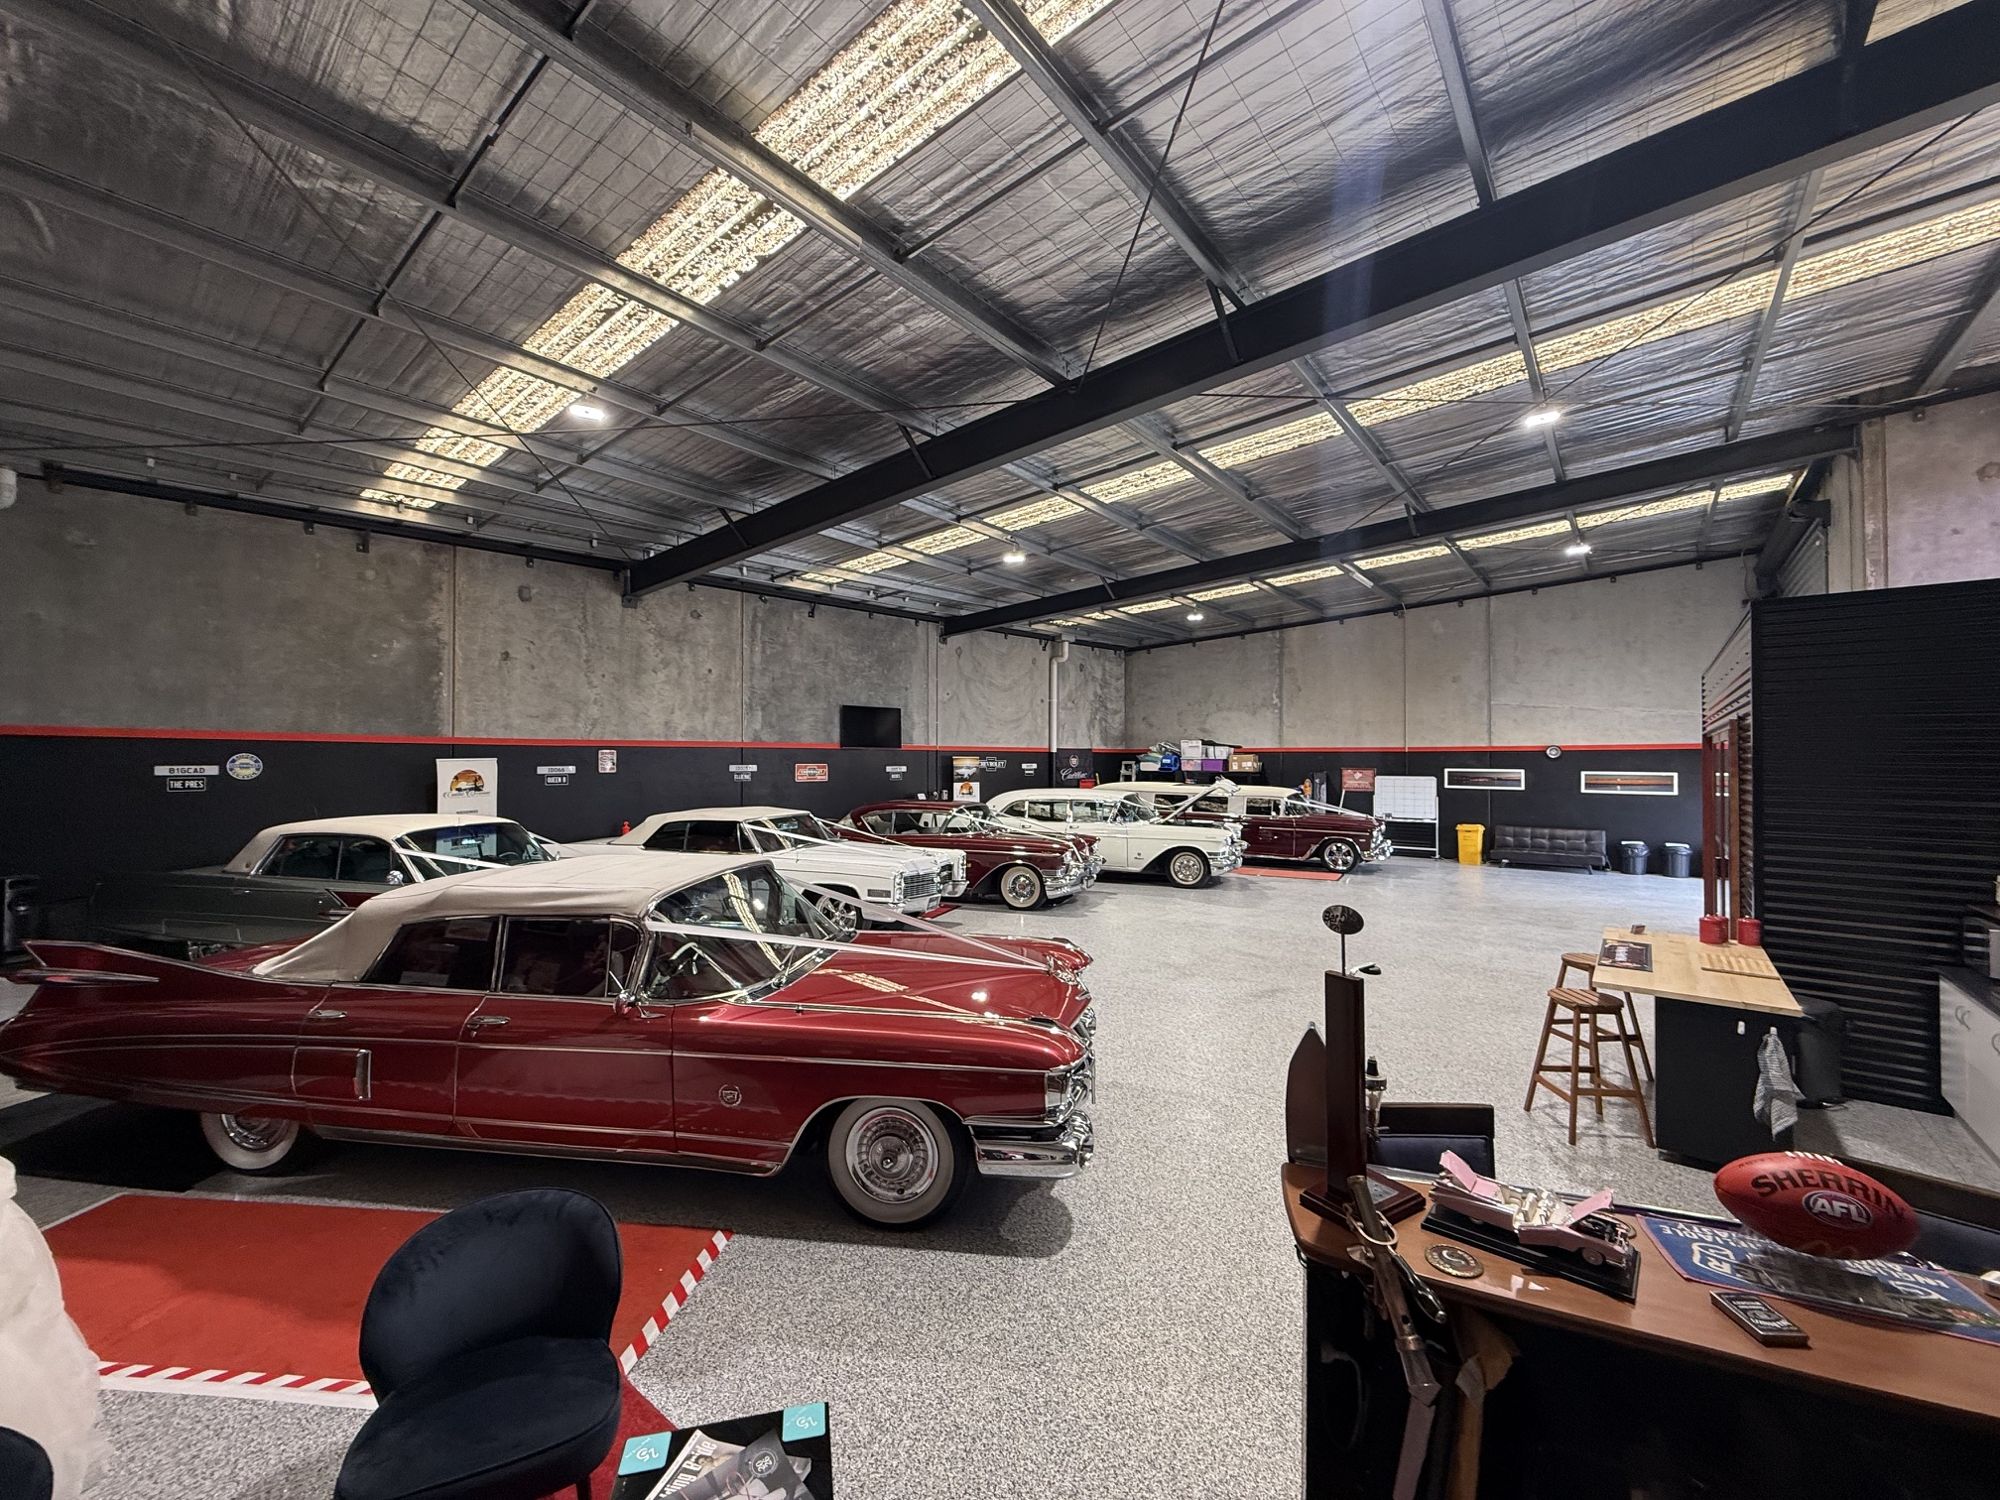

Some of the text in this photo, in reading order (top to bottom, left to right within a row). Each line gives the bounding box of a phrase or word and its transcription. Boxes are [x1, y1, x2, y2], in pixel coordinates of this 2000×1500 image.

[170, 780, 205, 789] THE PRES
[1750, 1168, 1905, 1219] SHERRIN
[1811, 1197, 1869, 1223] AFL
